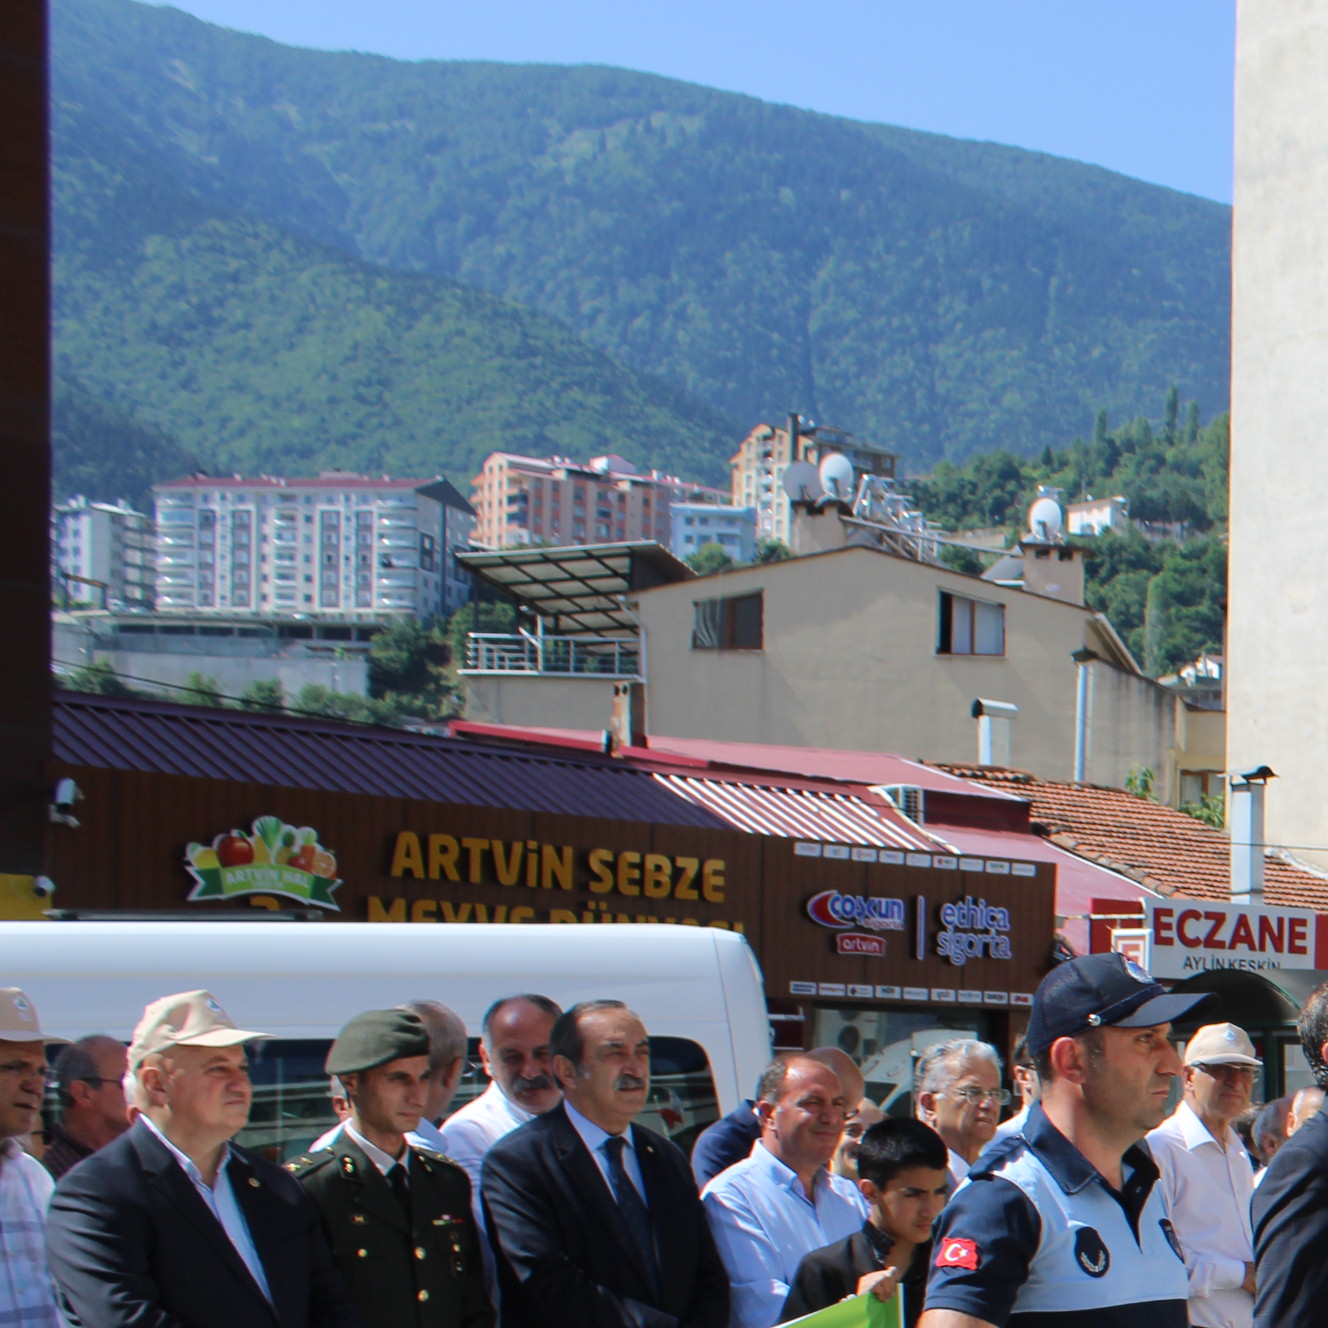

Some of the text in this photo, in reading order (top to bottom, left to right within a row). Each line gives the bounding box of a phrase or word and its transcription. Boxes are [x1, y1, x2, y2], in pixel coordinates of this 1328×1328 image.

[588, 848, 726, 903] SEBZE
[940, 896, 1011, 931] ethica
[1153, 907, 1309, 955] ECZANE
[937, 929, 1013, 967] sigorta
[1183, 954, 1225, 970] AYLİN
